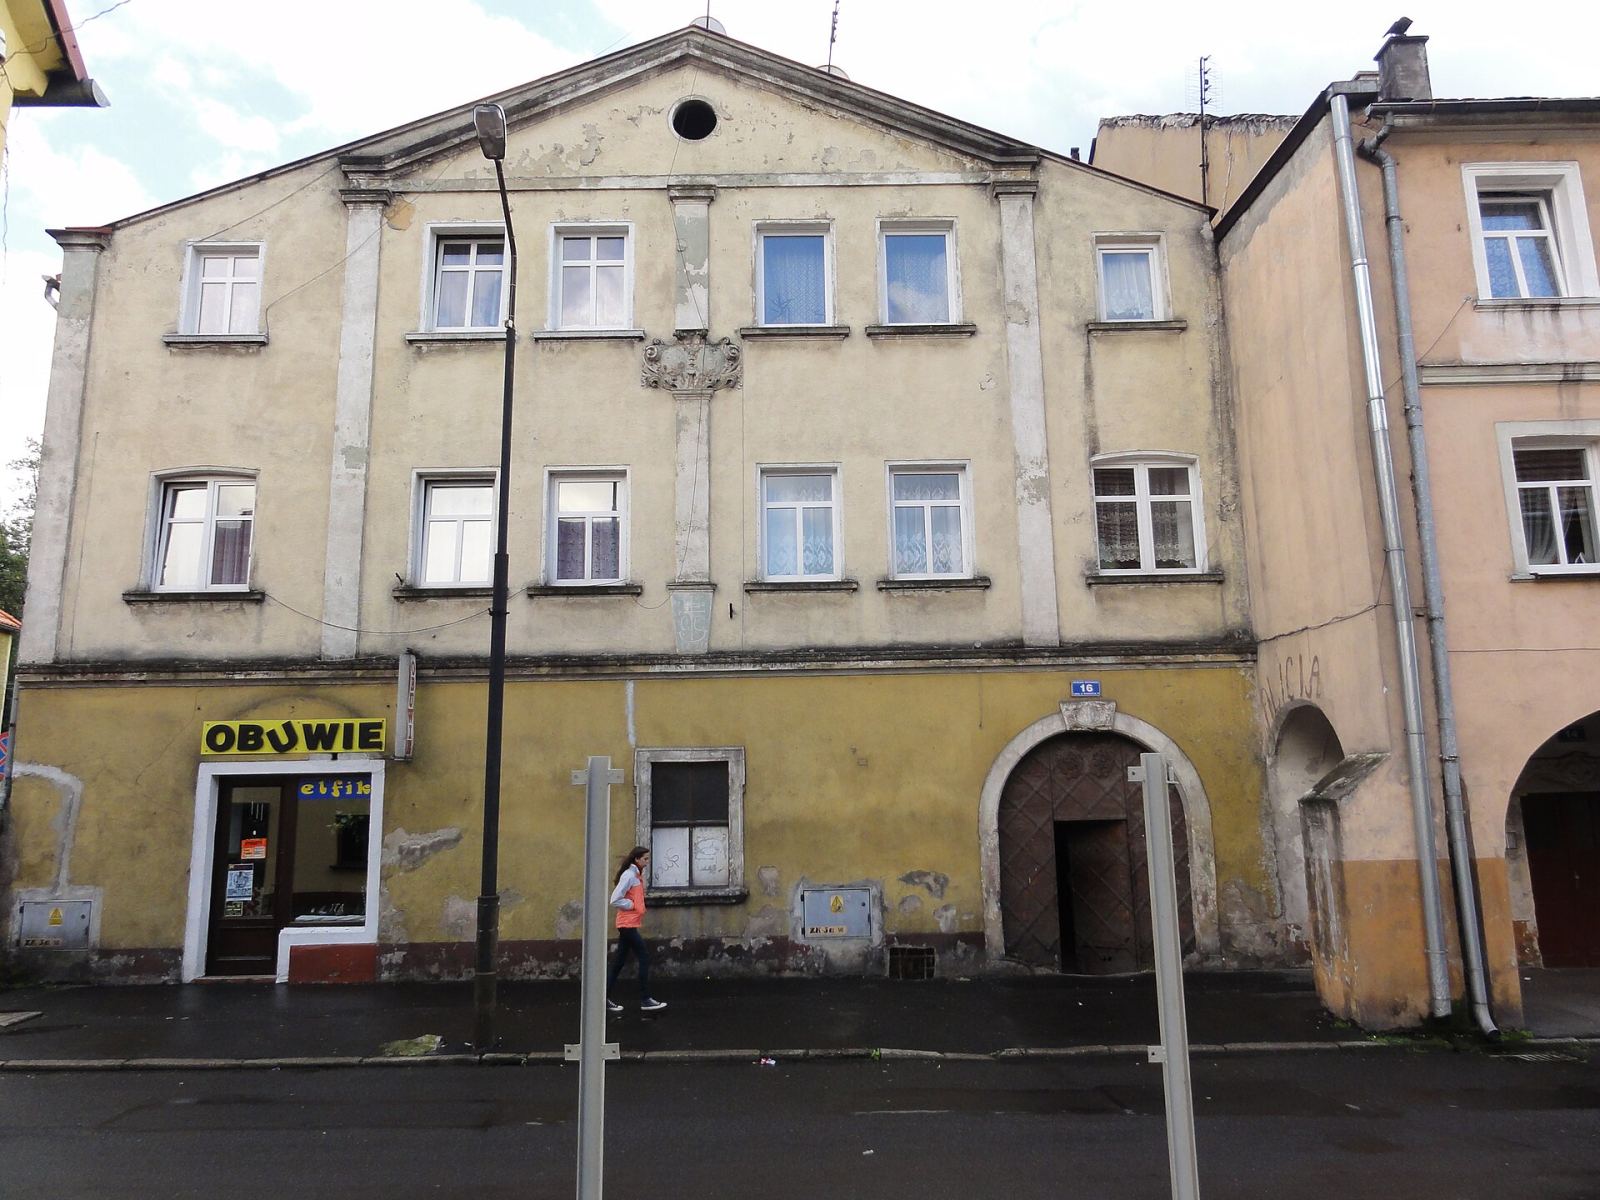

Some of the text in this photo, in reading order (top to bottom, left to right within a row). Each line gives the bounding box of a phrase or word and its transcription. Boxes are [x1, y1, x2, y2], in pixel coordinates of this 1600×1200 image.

[1079, 683, 1094, 693] 16
[206, 721, 383, 752] OBUWIE
[300, 780, 372, 798] elfik
